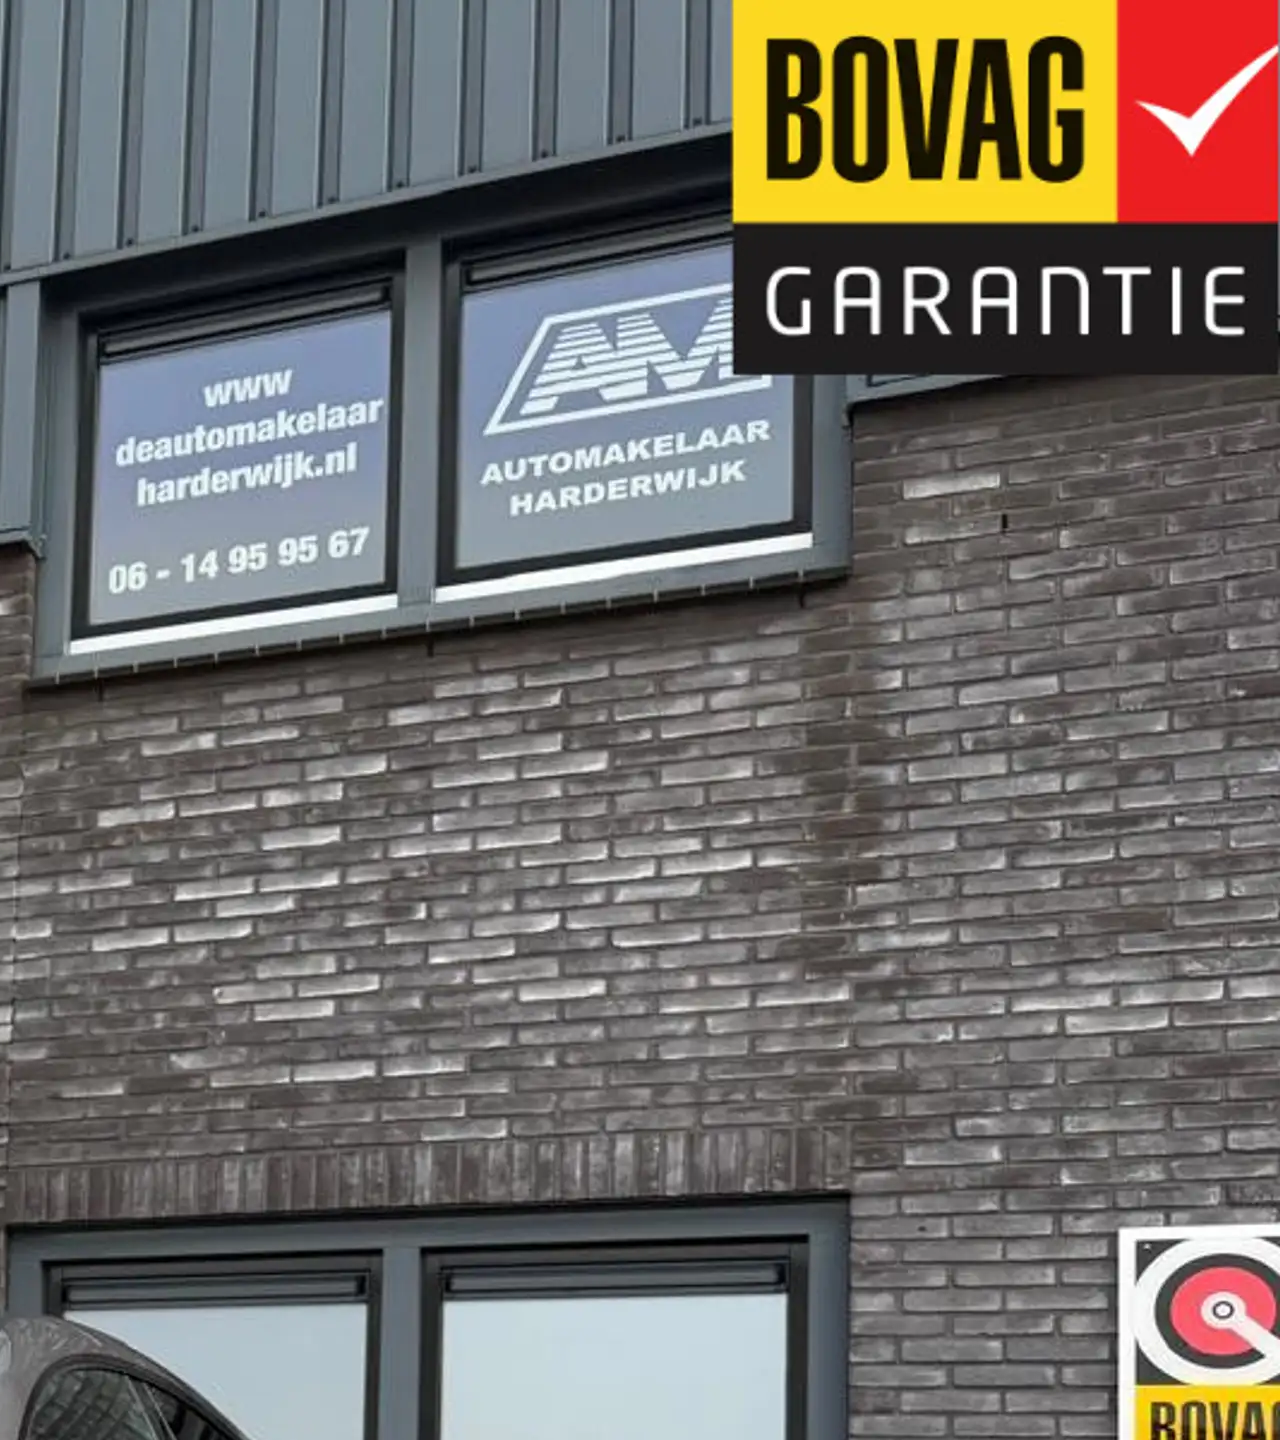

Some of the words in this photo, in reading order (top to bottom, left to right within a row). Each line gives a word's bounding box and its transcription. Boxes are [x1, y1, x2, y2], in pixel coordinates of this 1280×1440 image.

[203, 369, 293, 408] www
[115, 398, 384, 467] deautomakelaar
[480, 419, 772, 487] AUTOMAKELAAR
[137, 441, 358, 507] harderwijk.nl
[509, 458, 747, 517] HARDERWIJK
[108, 560, 148, 594] 06
[180, 550, 219, 583] 14
[227, 542, 268, 574] 95
[277, 535, 318, 567] 95
[327, 526, 370, 559] 67
